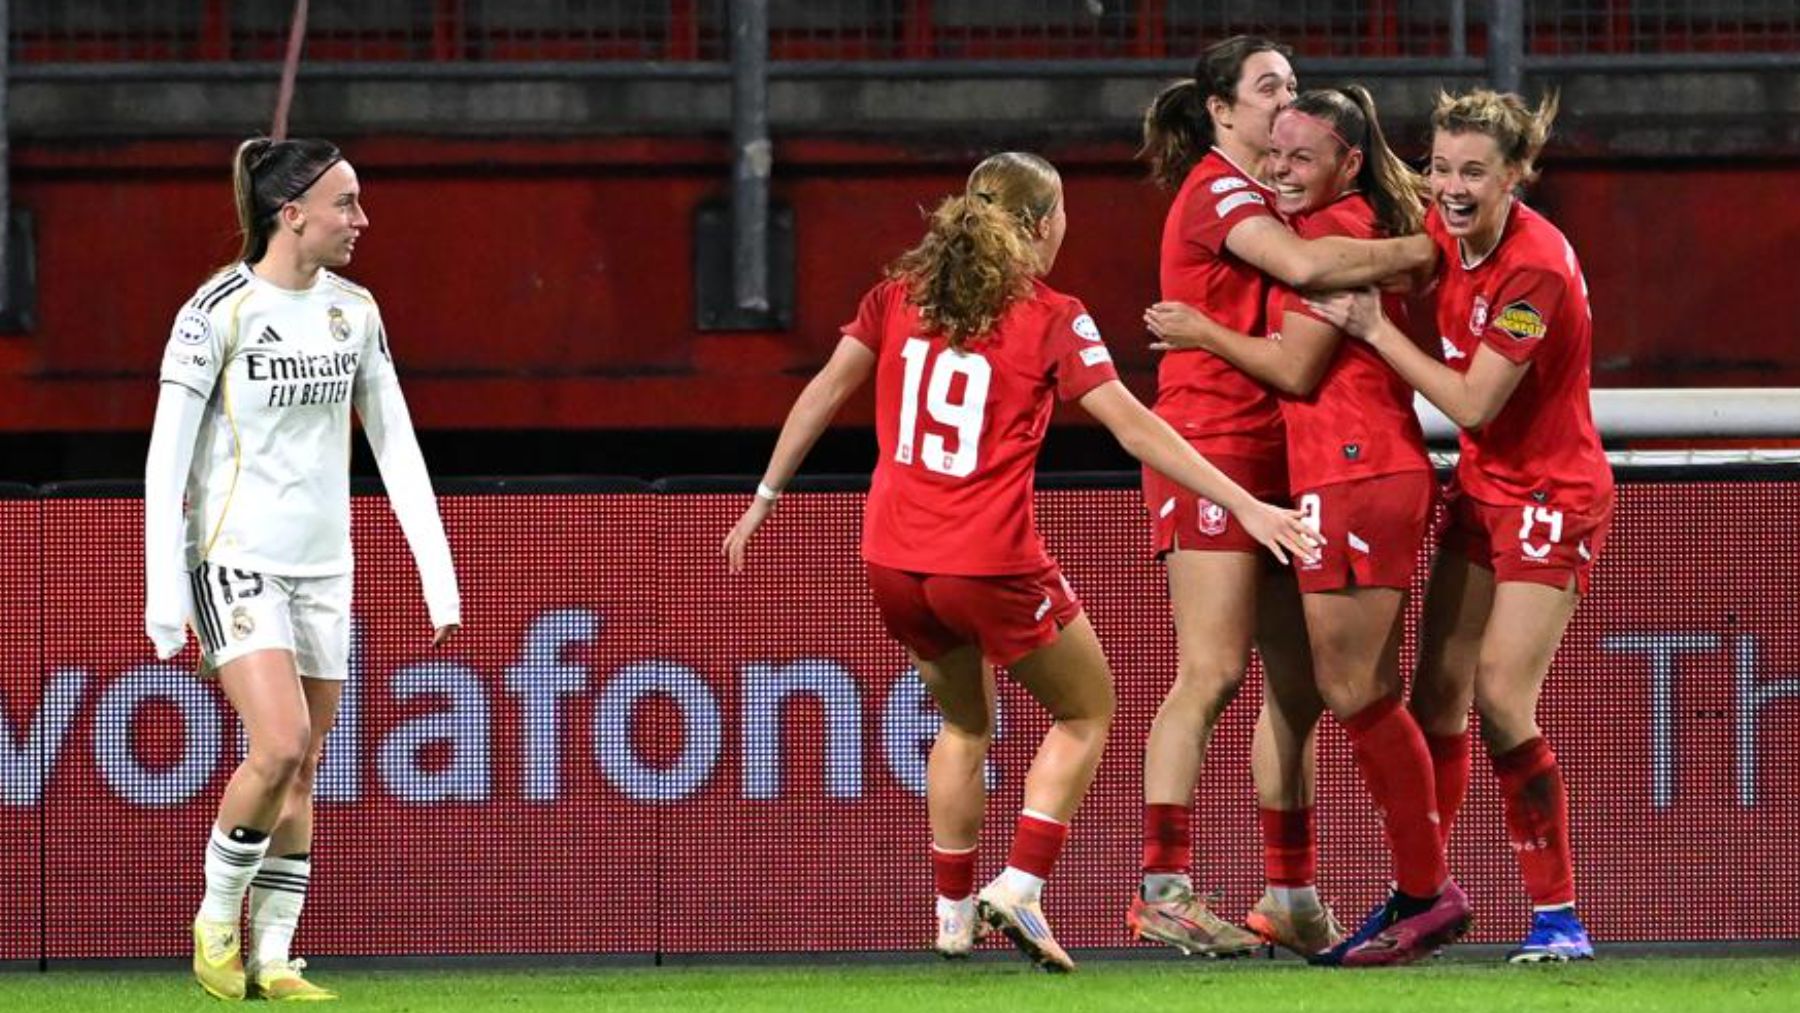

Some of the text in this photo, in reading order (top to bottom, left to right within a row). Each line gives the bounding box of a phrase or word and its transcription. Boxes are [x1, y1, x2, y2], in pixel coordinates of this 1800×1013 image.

[246, 350, 358, 381] Emirates
[268, 384, 297, 407] FLY
[894, 337, 992, 478] 19
[1519, 504, 1563, 543] 14
[219, 566, 264, 605] 19
